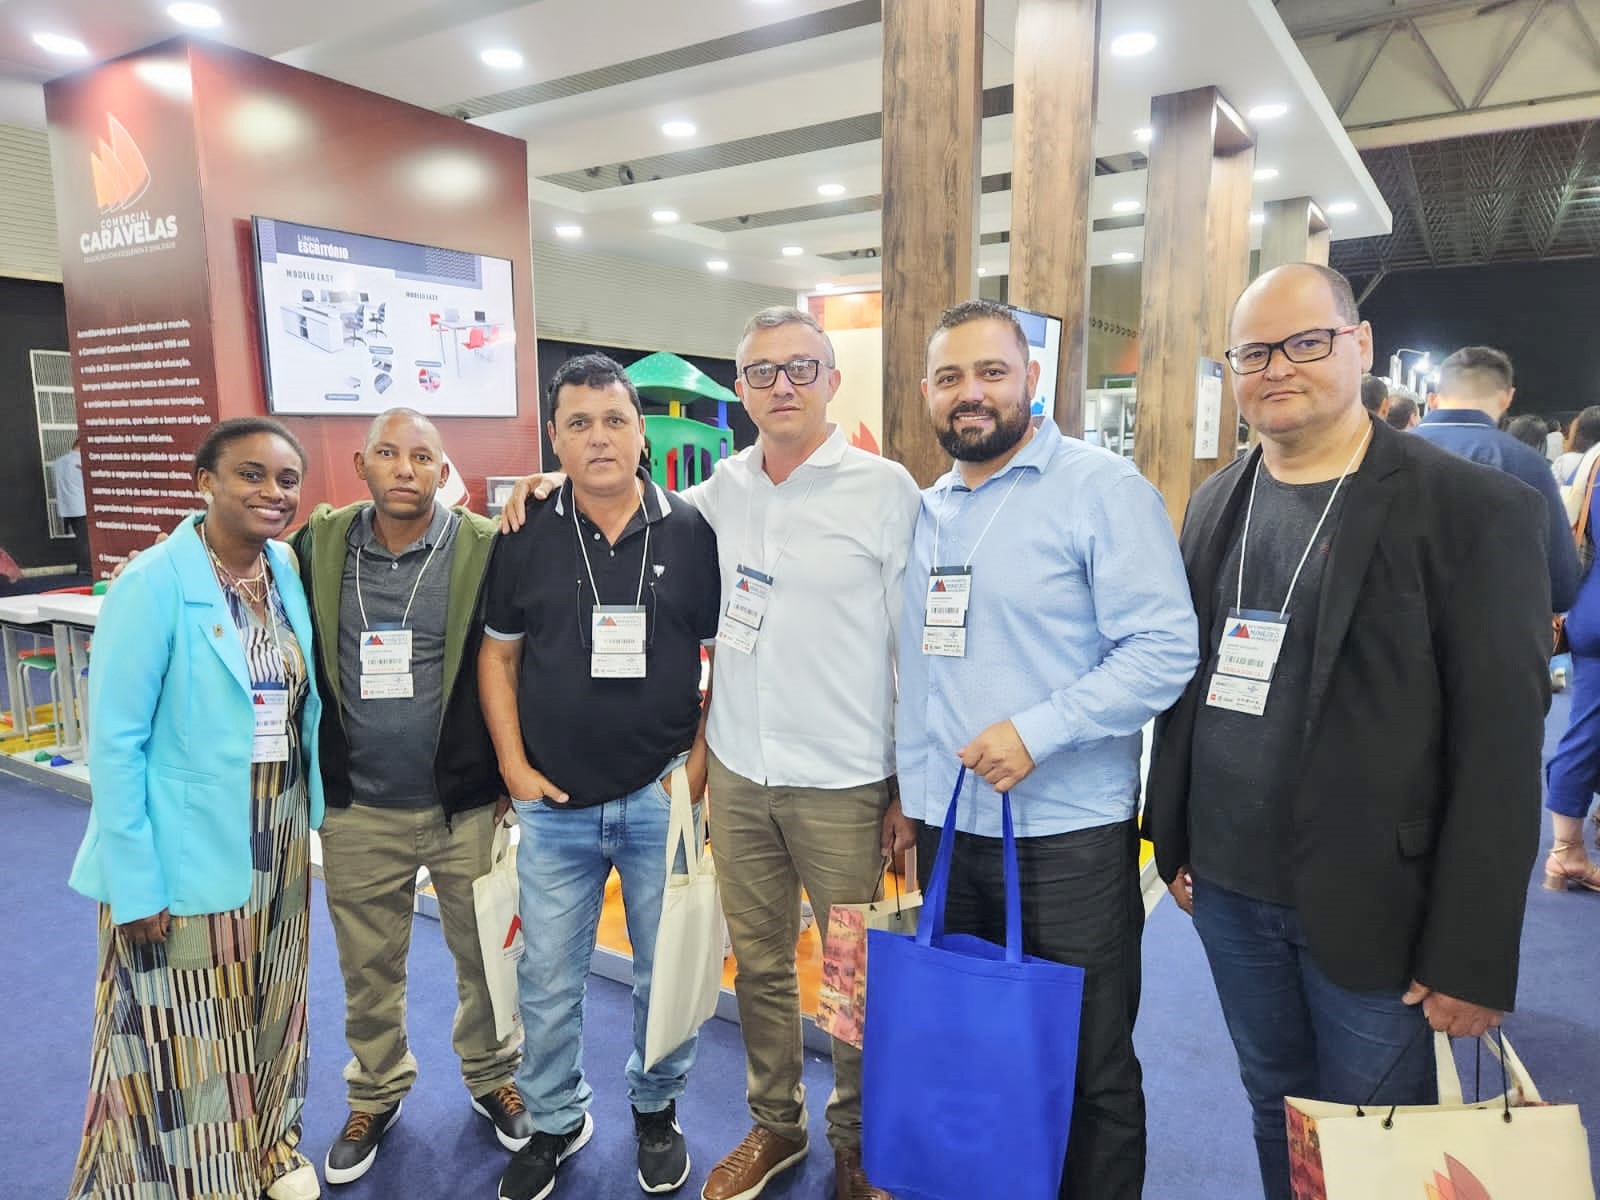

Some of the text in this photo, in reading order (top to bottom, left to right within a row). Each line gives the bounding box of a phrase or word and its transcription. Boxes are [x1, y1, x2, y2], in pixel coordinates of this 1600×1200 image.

[100, 210, 151, 229] COMERCIAL
[80, 215, 178, 254] CARAVELAS
[297, 240, 349, 259] ESCRITÓRIO
[286, 269, 334, 282] MODELO EASY
[82, 346, 106, 356] Comercial
[107, 344, 130, 354] Caravelas
[130, 360, 154, 370] mercado
[166, 377, 186, 386] melhor
[186, 378, 200, 387] para
[132, 417, 142, 426] que
[101, 452, 123, 462] produtos
[116, 488, 126, 496] que
[141, 488, 160, 496] melhor
